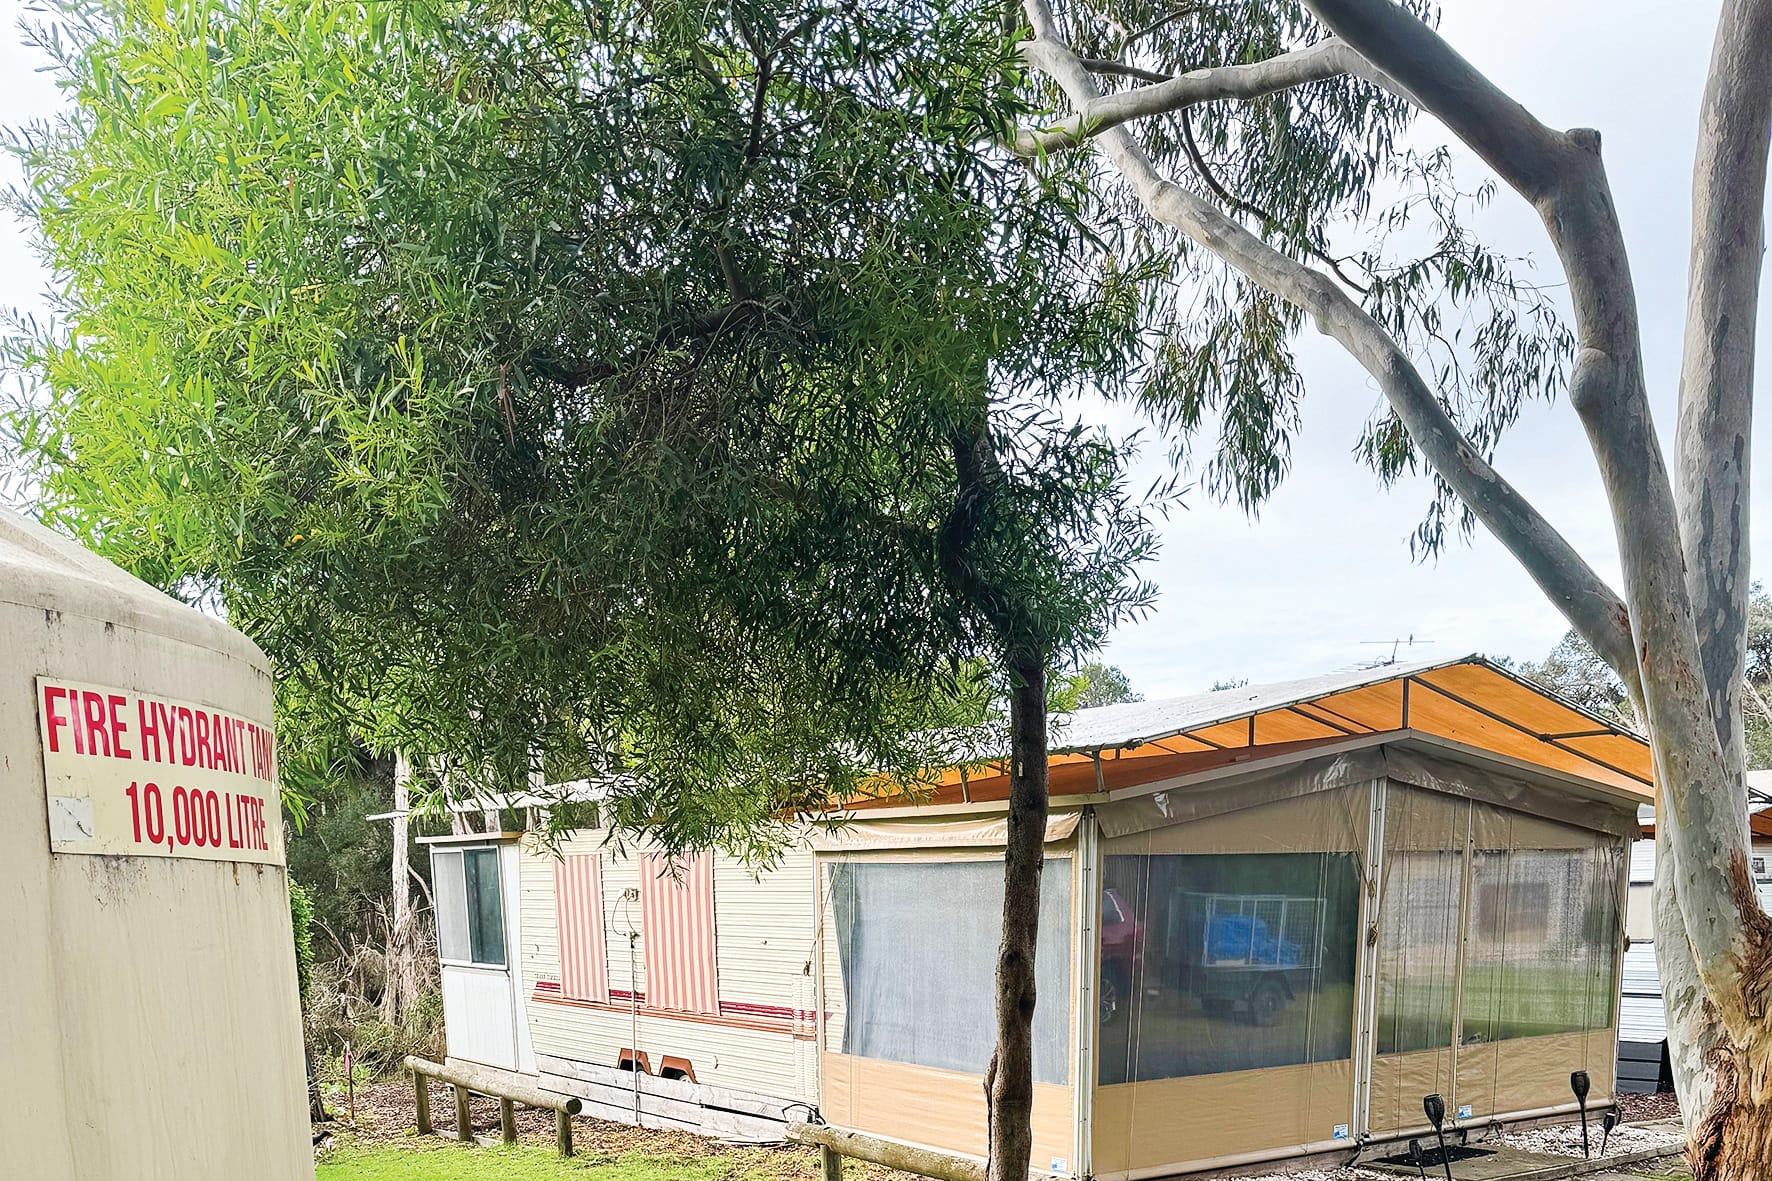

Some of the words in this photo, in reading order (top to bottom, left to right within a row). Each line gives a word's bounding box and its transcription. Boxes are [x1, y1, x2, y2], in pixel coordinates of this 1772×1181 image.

[43, 685, 132, 760] FIRE
[138, 699, 247, 775] HYDRANT
[125, 781, 222, 854] 10,000
[225, 792, 269, 851] LITRE
